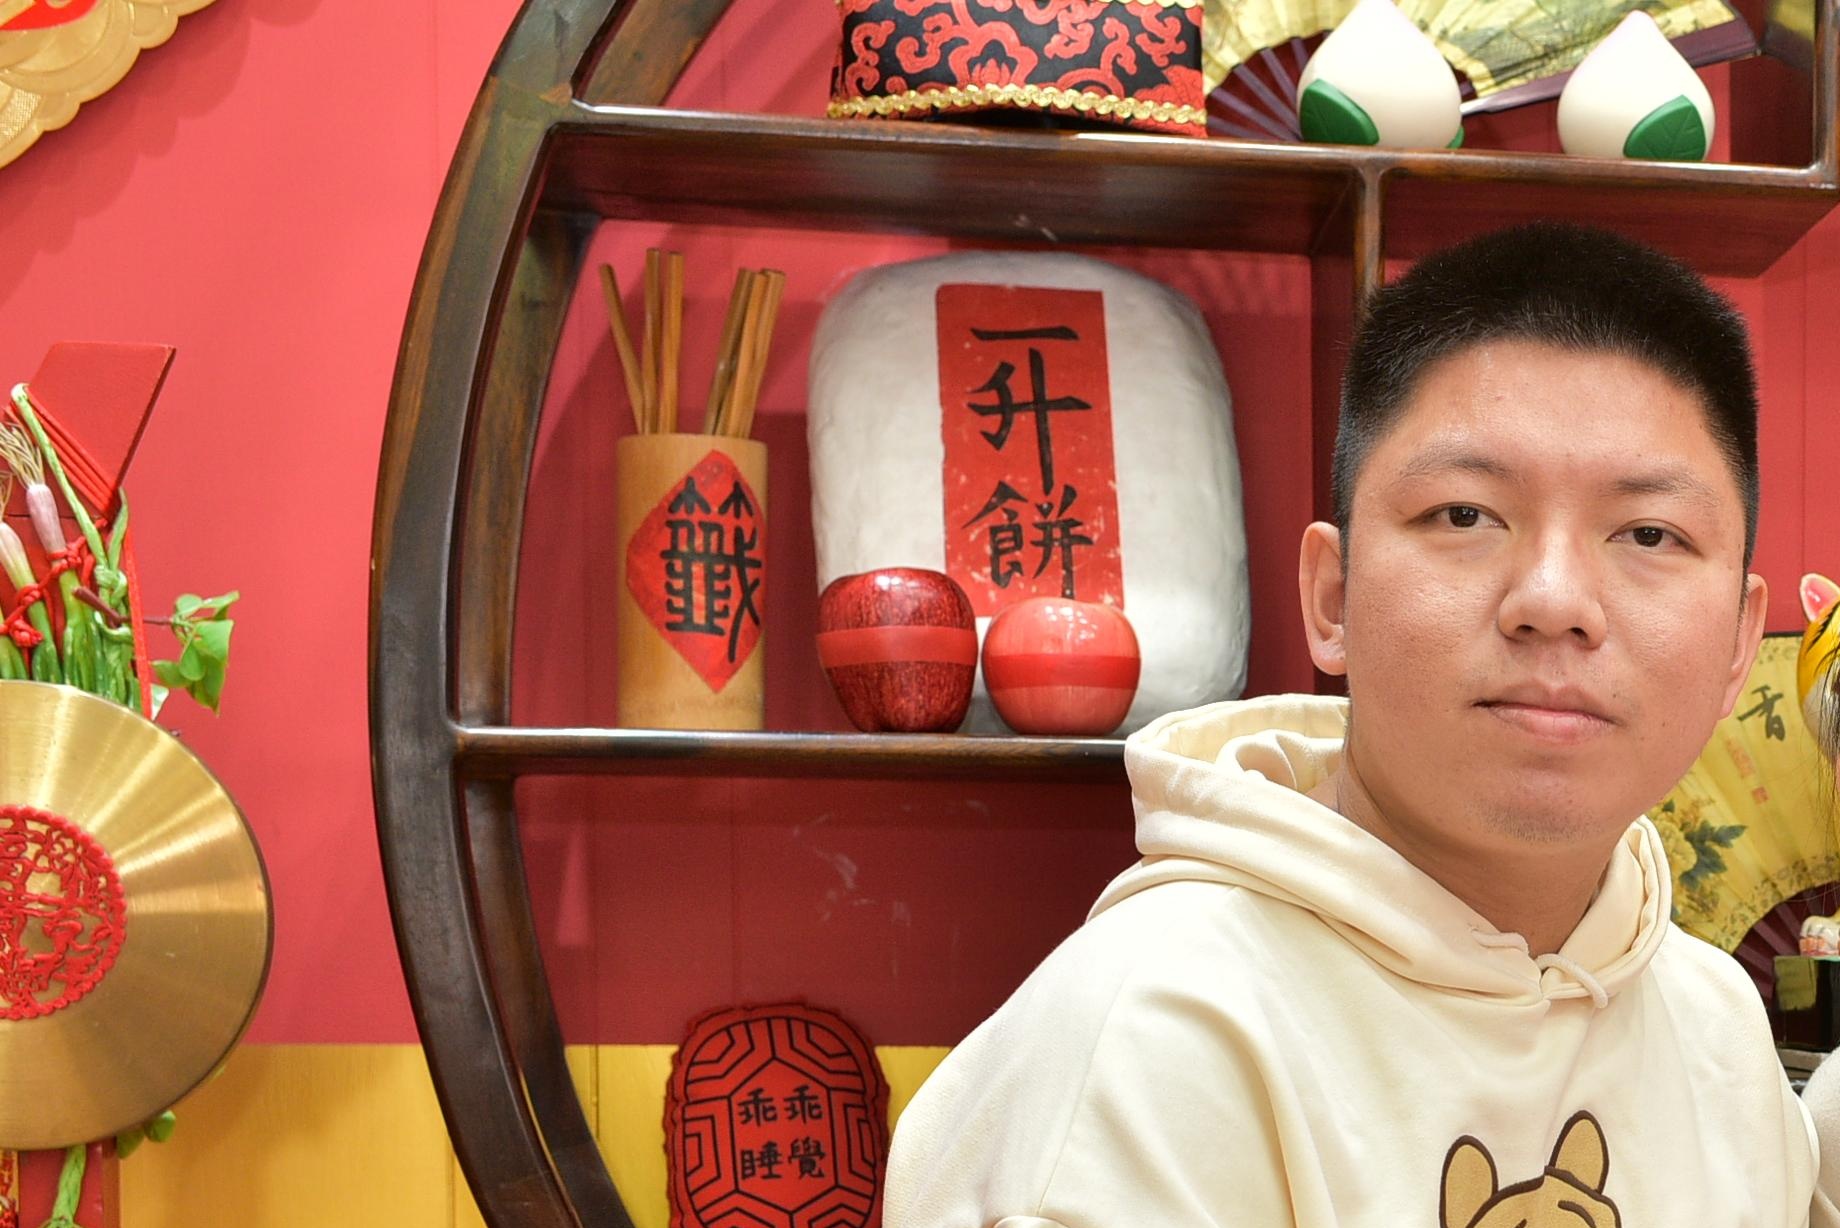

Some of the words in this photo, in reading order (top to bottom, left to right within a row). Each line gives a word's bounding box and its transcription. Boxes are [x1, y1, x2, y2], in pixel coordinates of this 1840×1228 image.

[963, 325, 1093, 600] 一升餅
[738, 1085, 822, 1126] 乖乖
[740, 1136, 825, 1180] 睡覺
